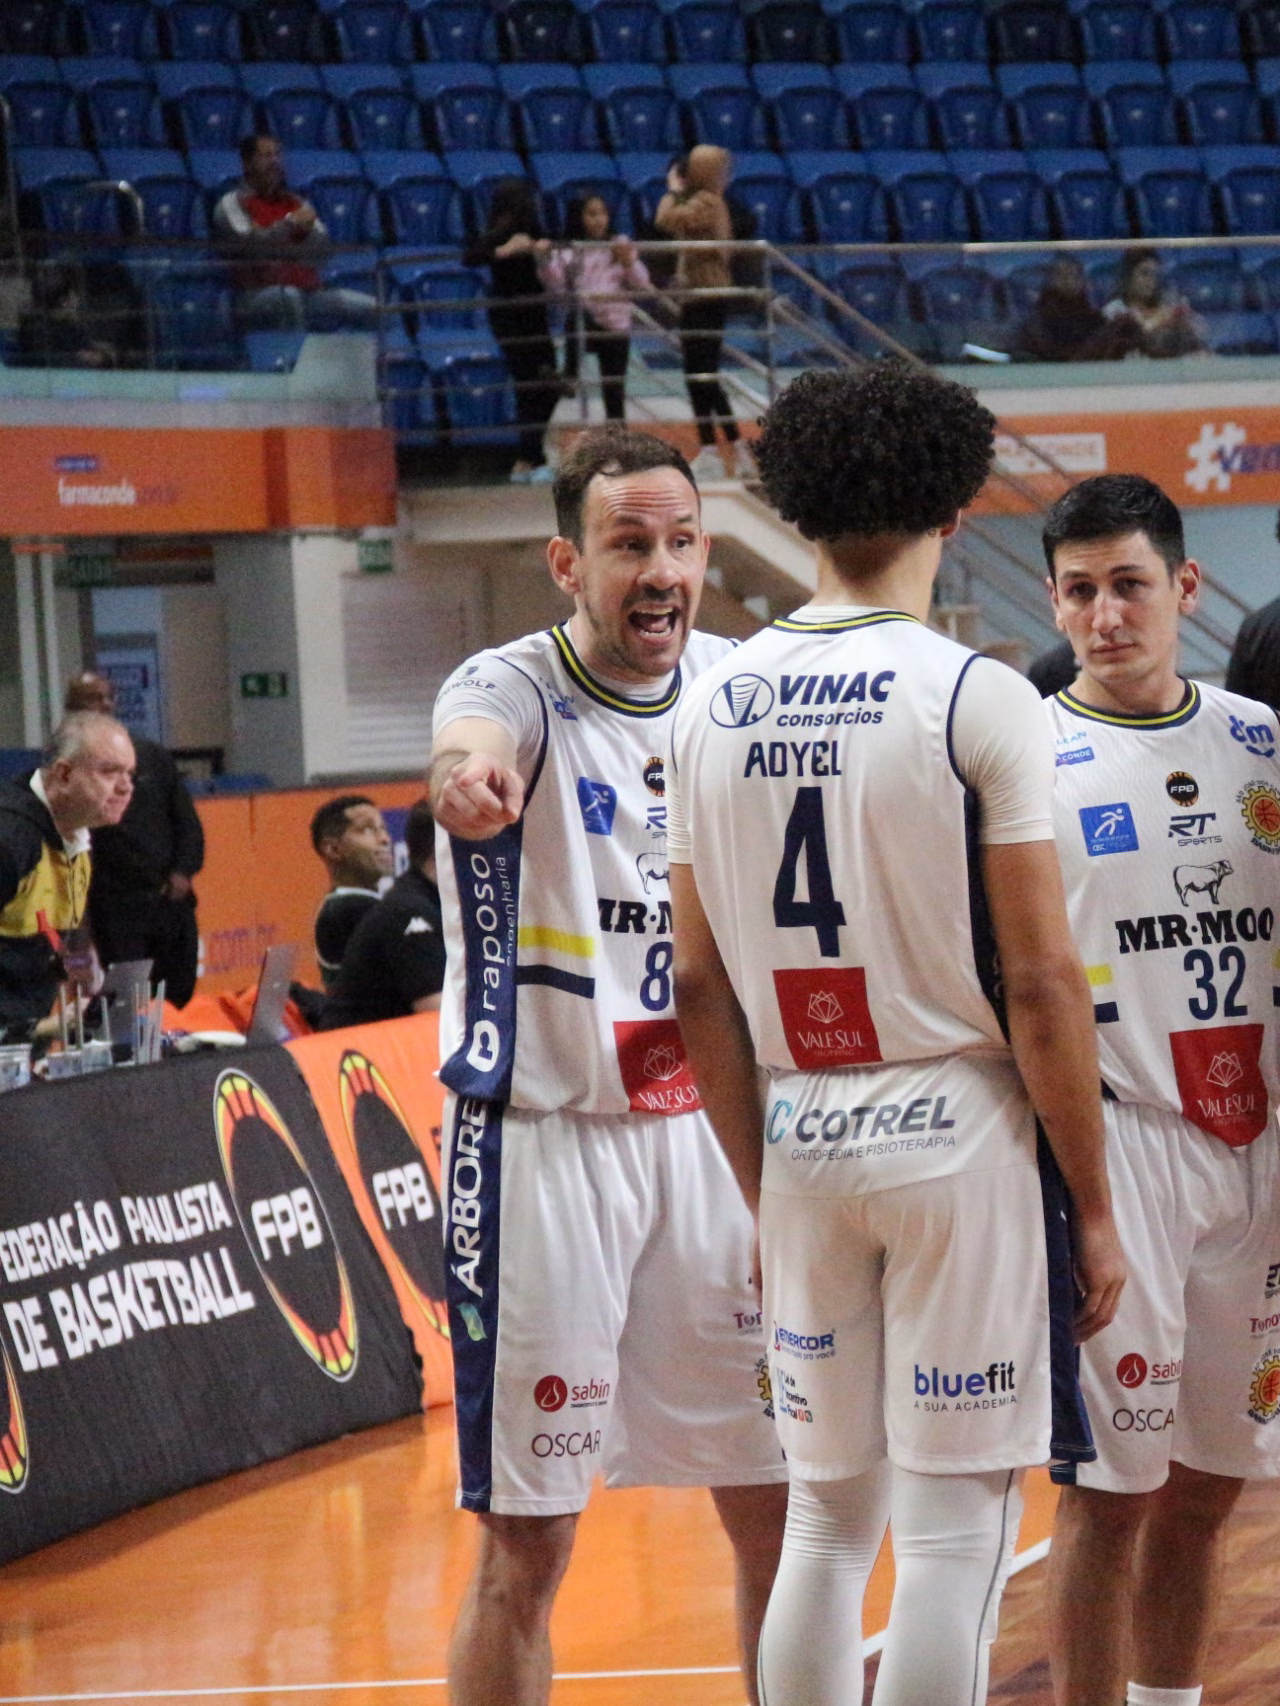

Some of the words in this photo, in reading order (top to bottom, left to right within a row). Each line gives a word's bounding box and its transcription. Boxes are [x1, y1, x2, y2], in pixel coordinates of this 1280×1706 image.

[779, 669, 897, 706] VINAC
[743, 739, 842, 779] ADYEL
[1169, 784, 1195, 795] FPB
[1167, 812, 1217, 838] RT
[1177, 835, 1223, 847] SPORTS
[772, 786, 847, 958] 4
[470, 853, 506, 1012] raposo
[639, 941, 673, 1012] 8
[1183, 945, 1249, 1021] 32
[795, 1095, 956, 1144] COTREL
[791, 1148, 854, 1162] ORTOPEDIA
[855, 1146, 864, 1158] E
[866, 1135, 956, 1157] FISIOTERAPIA
[372, 1161, 435, 1231] FPB
[0, 1200, 121, 1283] EDERAÇÃO
[120, 1180, 233, 1246] PAULISTA
[251, 1187, 324, 1262] FPB
[2, 1296, 59, 1373] DE
[49, 1246, 256, 1360] BASKETBALL
[571, 1377, 610, 1401] sabin
[914, 1360, 1016, 1398] bluefit
[923, 1401, 949, 1413] SUA
[954, 1394, 1017, 1413] ACADEMIA
[1112, 1407, 1175, 1433] OSCA
[531, 1429, 601, 1458] OSCAR
